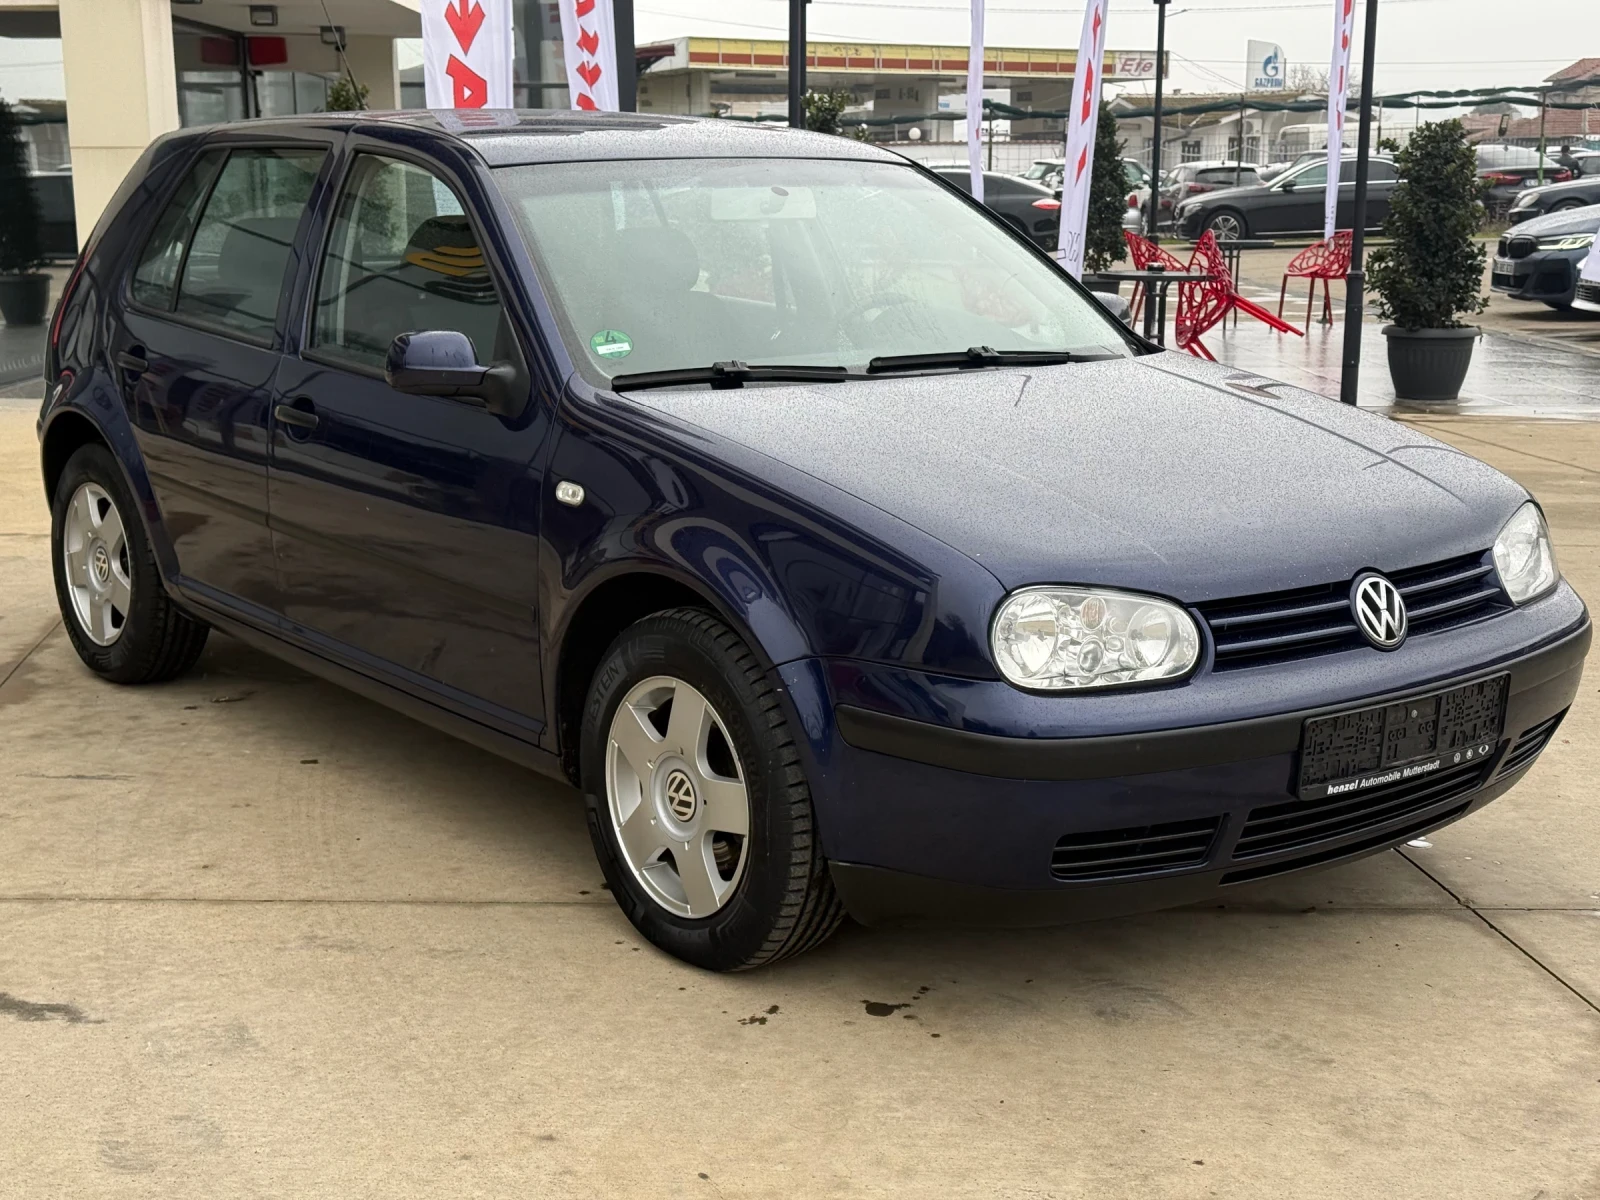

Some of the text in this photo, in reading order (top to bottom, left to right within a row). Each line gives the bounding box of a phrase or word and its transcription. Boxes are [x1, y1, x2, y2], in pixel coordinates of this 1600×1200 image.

[1327, 760, 1441, 795] henzel Automobile Mutterstadt
